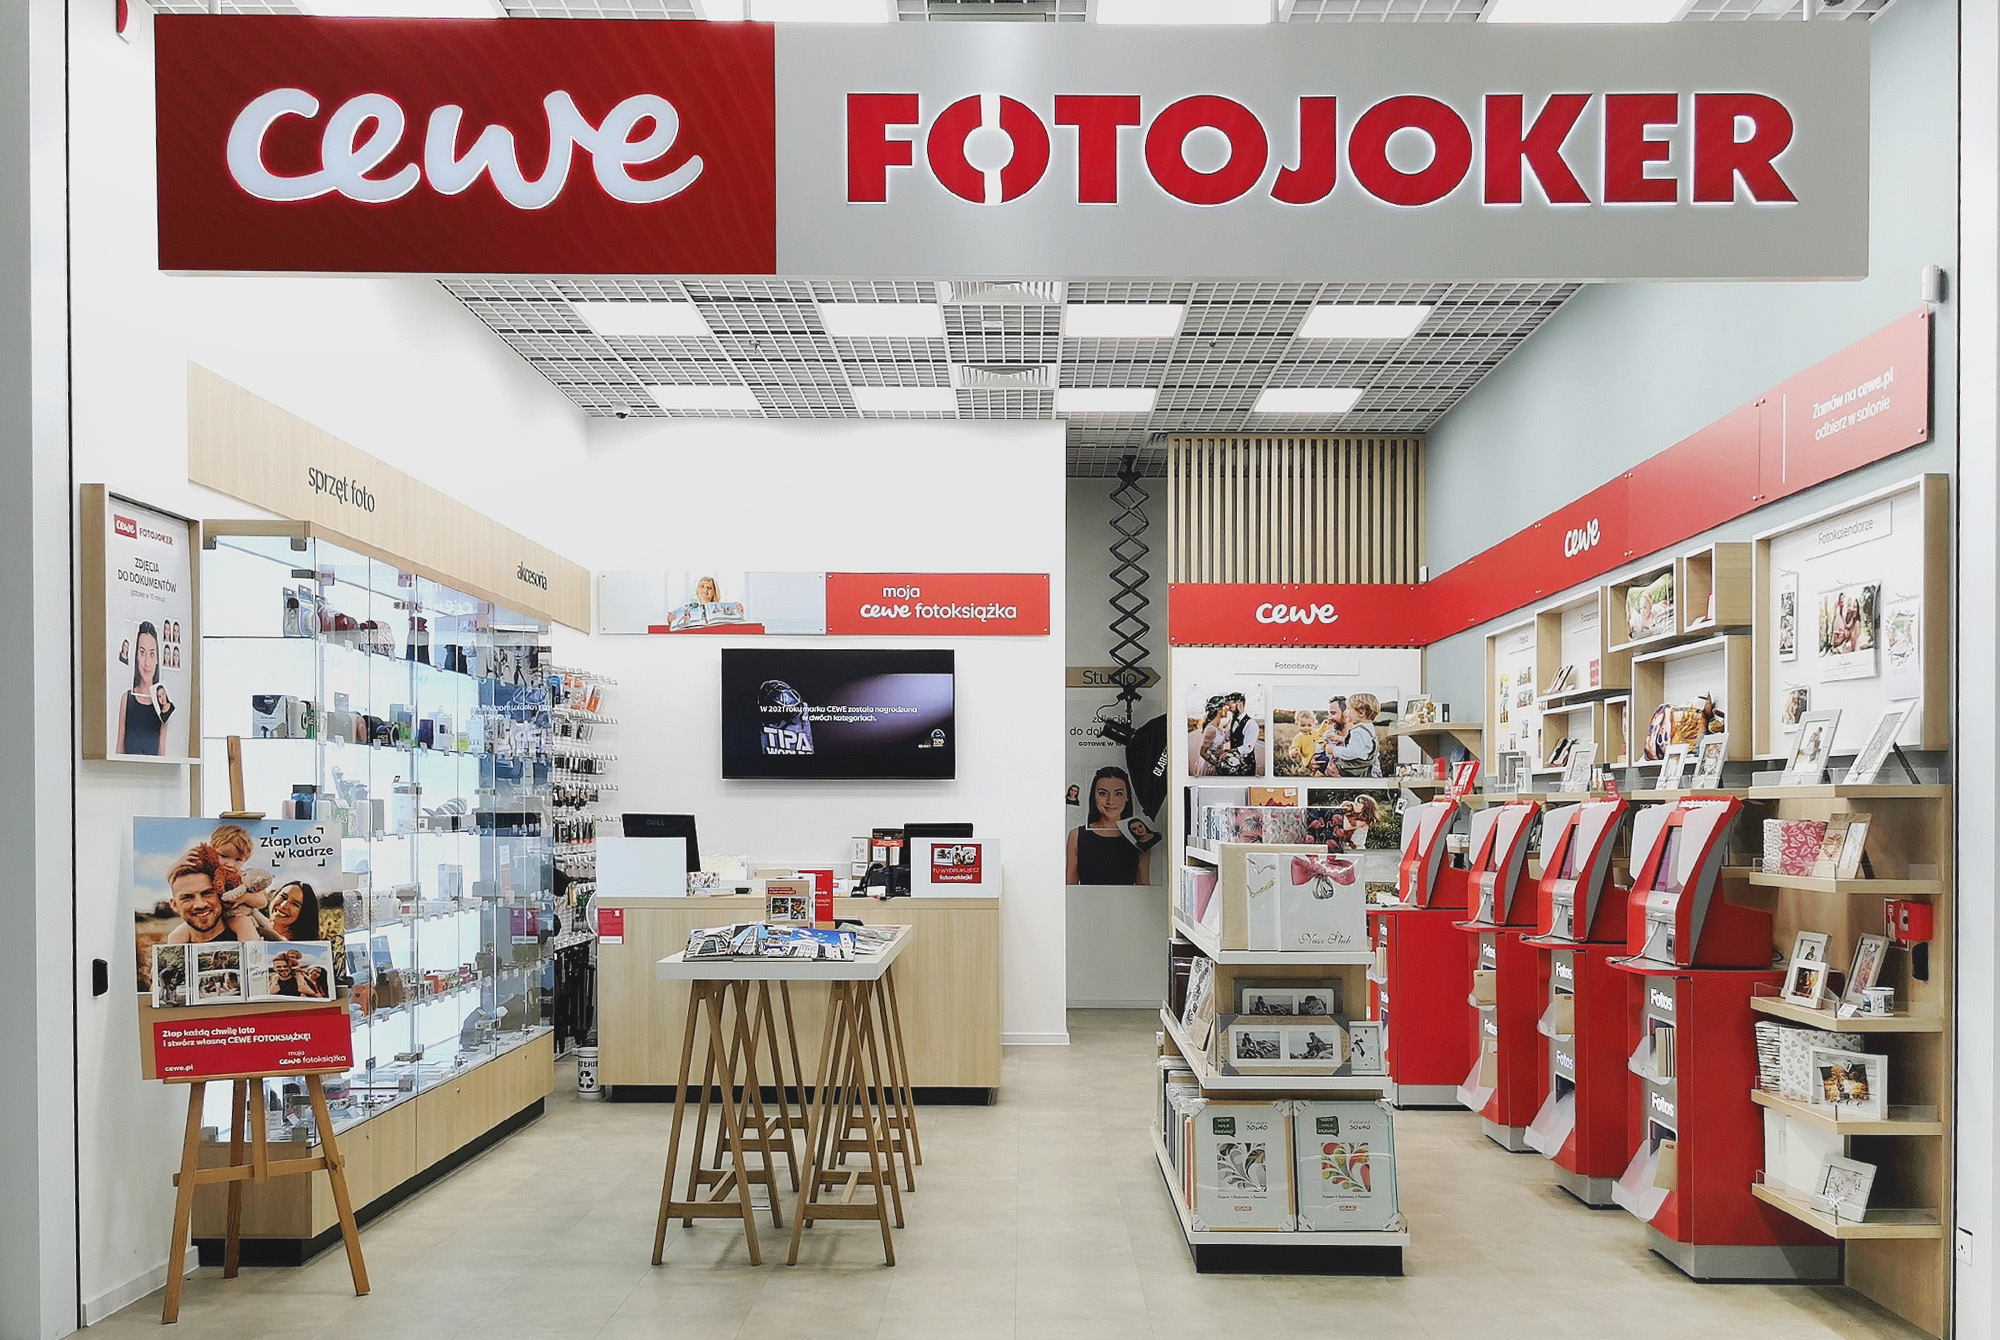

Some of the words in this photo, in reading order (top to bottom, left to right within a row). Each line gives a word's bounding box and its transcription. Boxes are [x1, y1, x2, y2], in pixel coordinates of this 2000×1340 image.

[226, 87, 704, 210] cewe
[846, 92, 1799, 206] FOTOJOKER
[1811, 394, 1844, 419] Zamów
[1844, 388, 1857, 404] na
[1857, 365, 1894, 398] cewe.pl
[1815, 417, 1848, 441] odbierz
[1847, 413, 1857, 426] w
[1856, 396, 1891, 422] salonie
[308, 466, 350, 504] sprzęt
[350, 479, 375, 512] foto
[115, 520, 136, 534] cewe
[139, 527, 173, 546] FOTOJOKER
[1564, 517, 1601, 558] cewe
[1818, 519, 1873, 545] Fotokalendarze
[134, 557, 160, 574] ZDJĘCIA
[117, 569, 129, 582] DO
[129, 571, 177, 593] DOKUMENTÓW
[517, 561, 548, 591] akcesoria
[882, 585, 921, 600] moja
[859, 603, 912, 619] cewe
[914, 603, 1017, 623] fotoksiążka
[1255, 602, 1339, 625] cewe
[1275, 662, 1318, 671] Fotoobrazy
[760, 705, 768, 713] W
[768, 705, 785, 713] 2021
[785, 705, 801, 713] roku
[802, 705, 826, 713] marka
[826, 705, 847, 713] CEWE
[874, 705, 918, 714] nagrodzona
[809, 713, 832, 721] dwóch
[764, 727, 812, 751] TIPA
[1070, 726, 1083, 736] do
[259, 836, 292, 848] Złap
[294, 834, 321, 845] lato
[274, 850, 285, 859] w
[288, 846, 334, 858] kadrze
[1555, 961, 1573, 980] Fotos
[1650, 987, 1673, 1012] Fotos
[162, 1029, 183, 1038] Złap
[184, 1028, 209, 1037] każdą
[211, 1027, 237, 1036] chwilę
[167, 1038, 195, 1047] stwórz
[196, 1038, 227, 1046] własną
[227, 1036, 252, 1044] CEWE
[164, 1064, 194, 1073] cewe.pl
[279, 1057, 302, 1065] cewe
[302, 1055, 347, 1064] fotoksiążka
[1556, 1050, 1574, 1069] Fotos
[1651, 1091, 1674, 1118] Fotos
